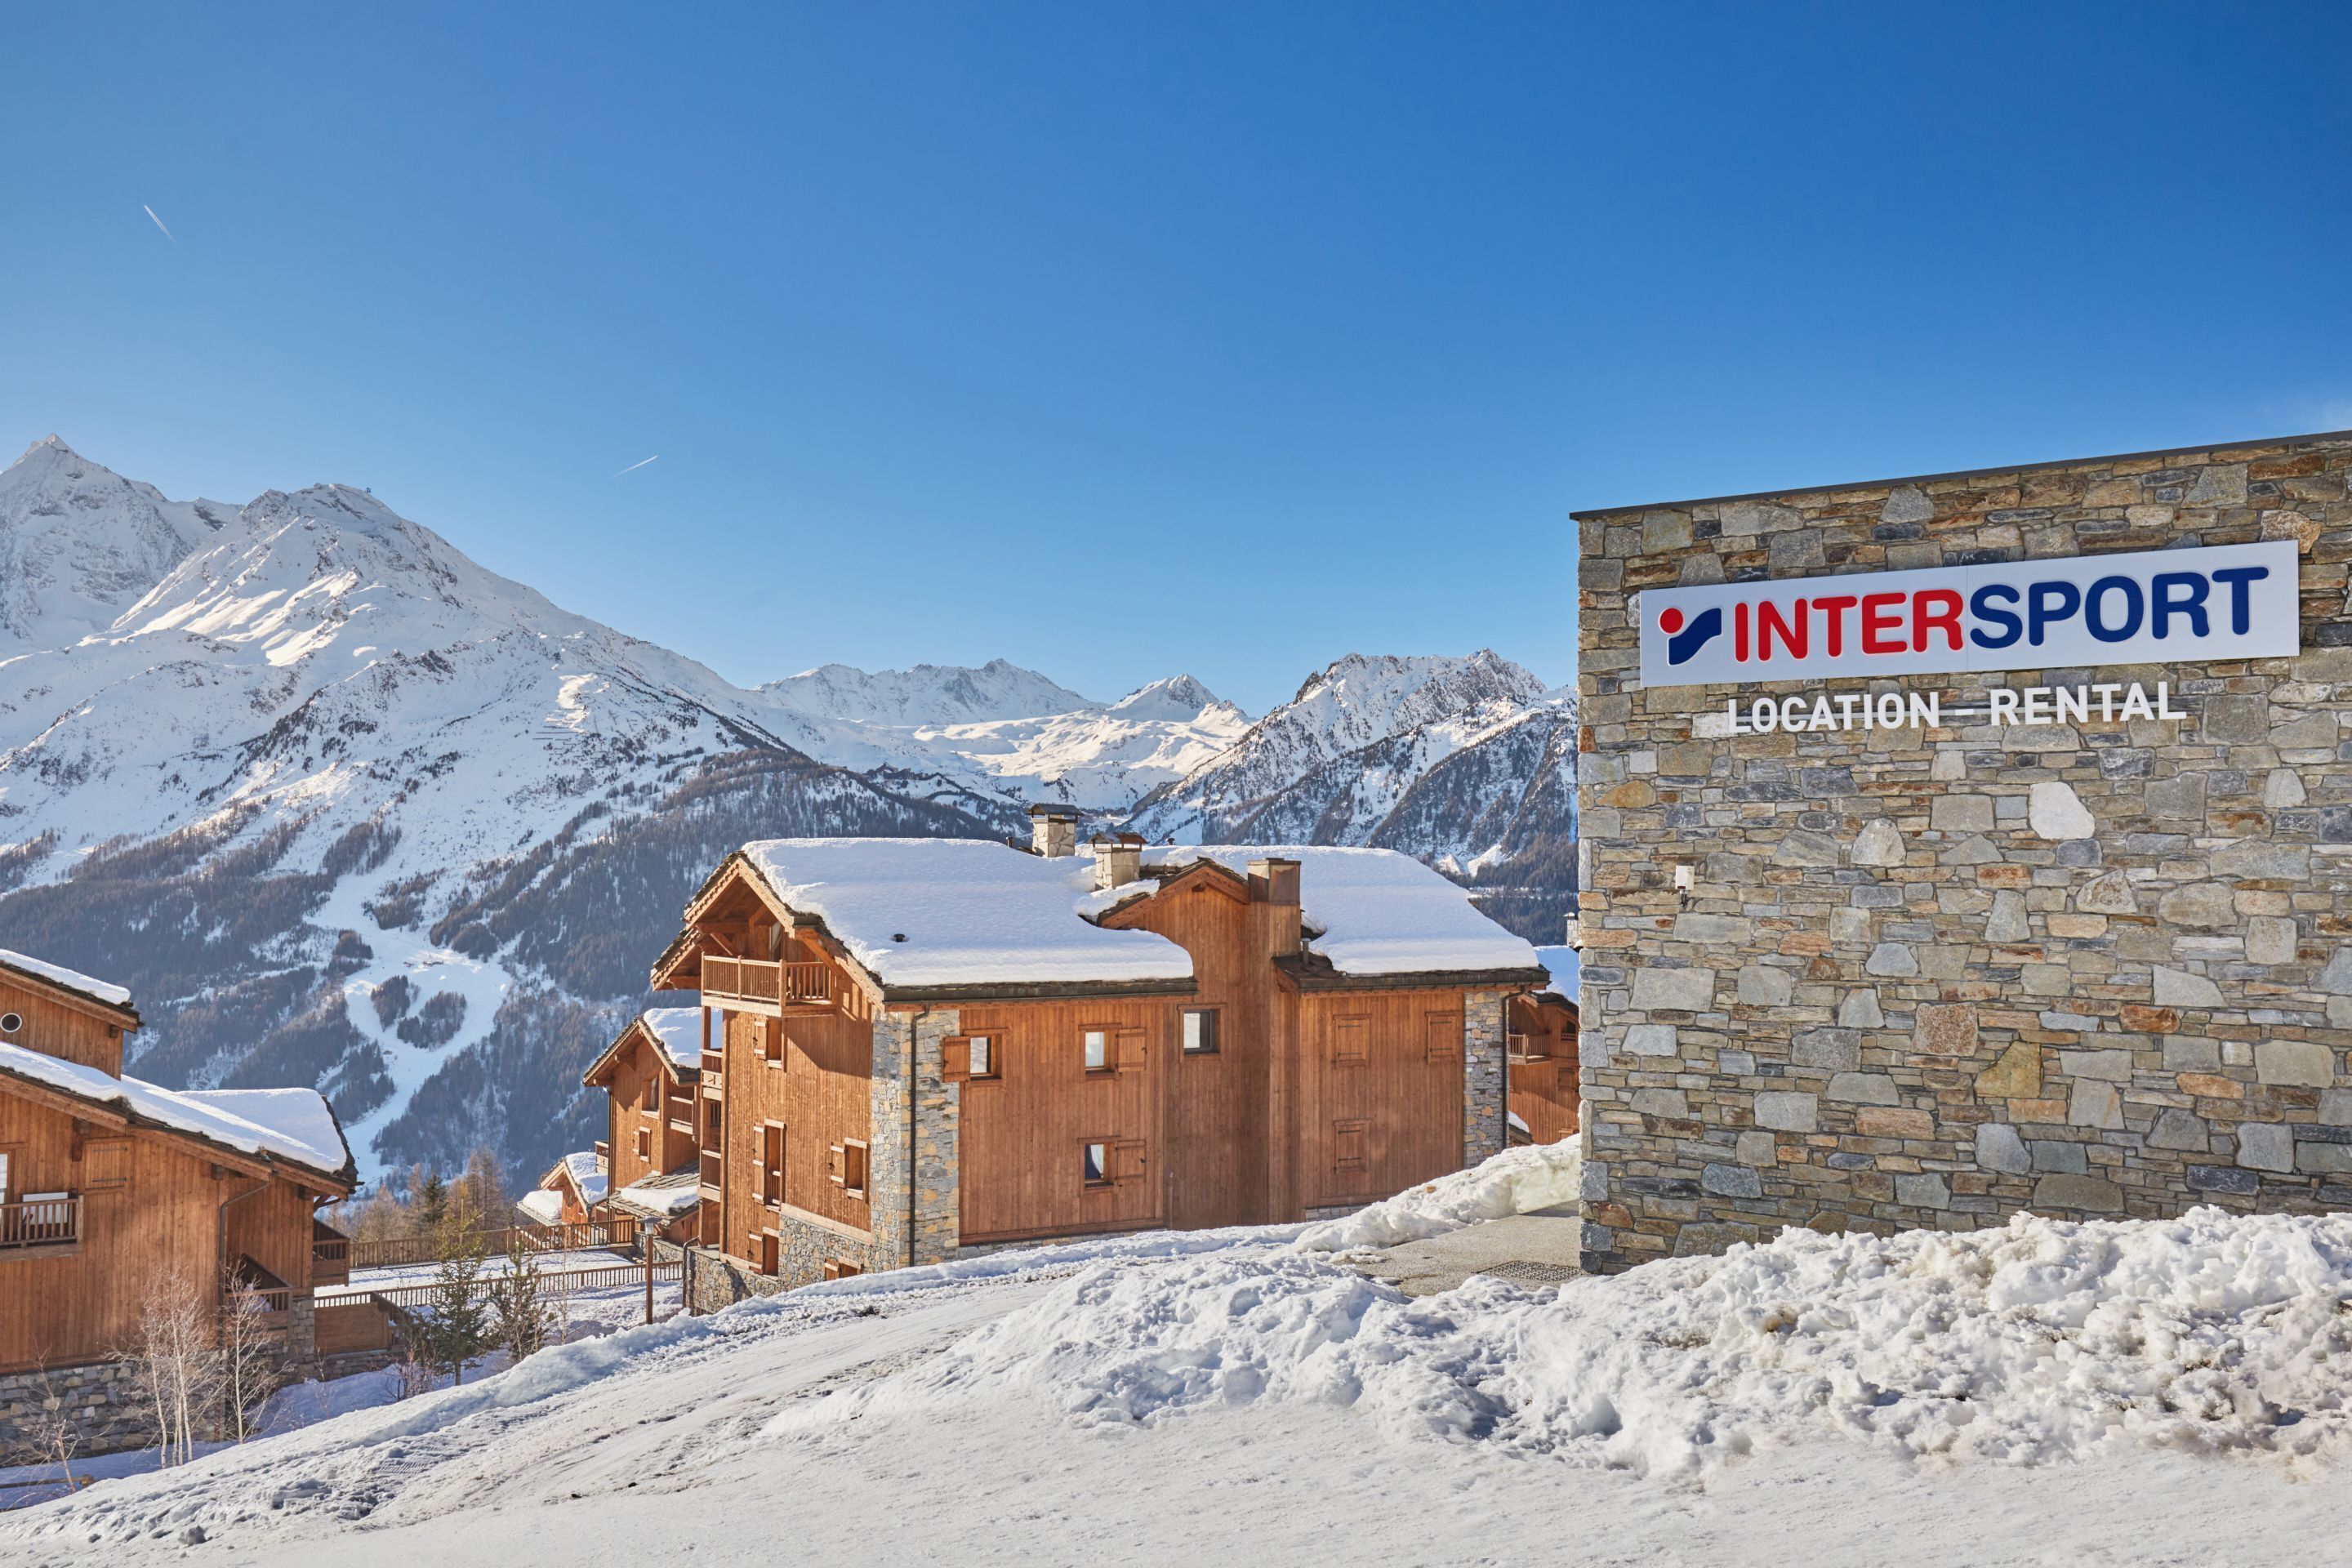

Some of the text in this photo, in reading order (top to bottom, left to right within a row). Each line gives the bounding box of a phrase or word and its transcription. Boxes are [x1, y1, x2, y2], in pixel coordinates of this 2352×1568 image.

[1735, 566, 2270, 663] INTERSPORT
[1727, 691, 1940, 733] LOCATION
[1989, 681, 2188, 726] RENTAL
